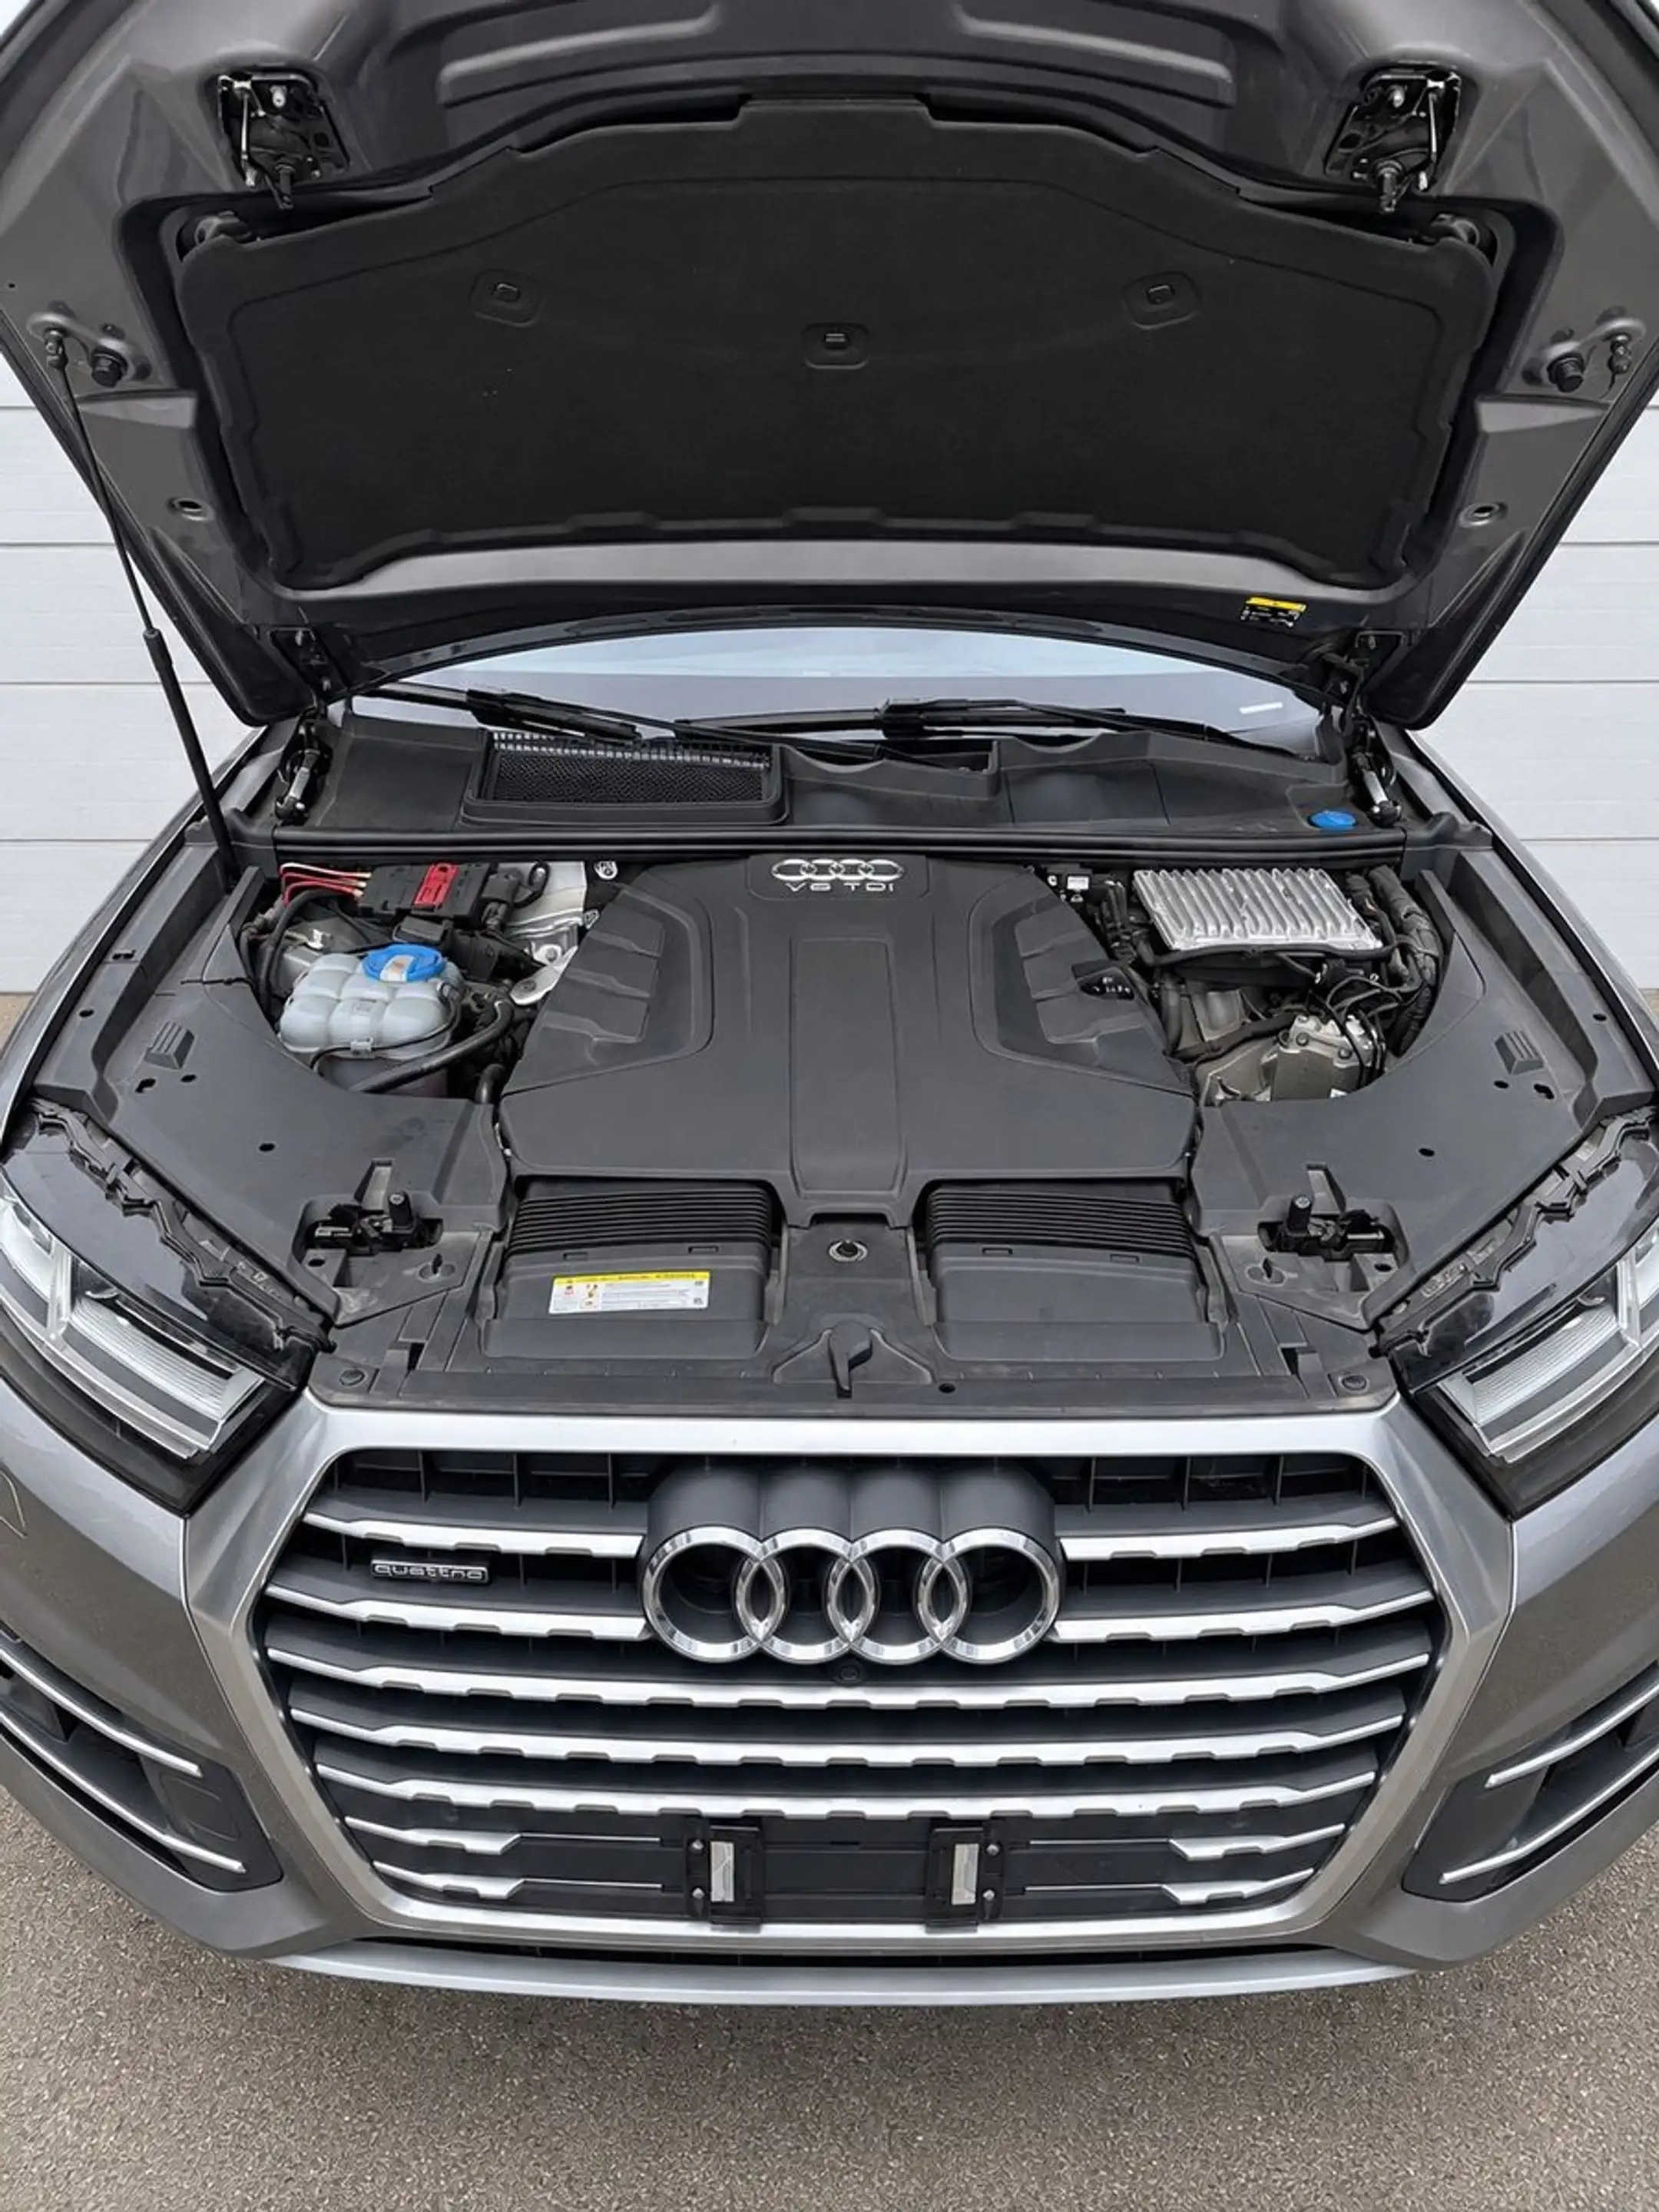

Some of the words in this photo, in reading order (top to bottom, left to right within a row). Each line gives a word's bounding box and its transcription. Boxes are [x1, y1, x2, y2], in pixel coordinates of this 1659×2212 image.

[785, 882, 831, 892] V6
[843, 882, 894, 892] TDI
[374, 1565, 482, 1580] quattro
